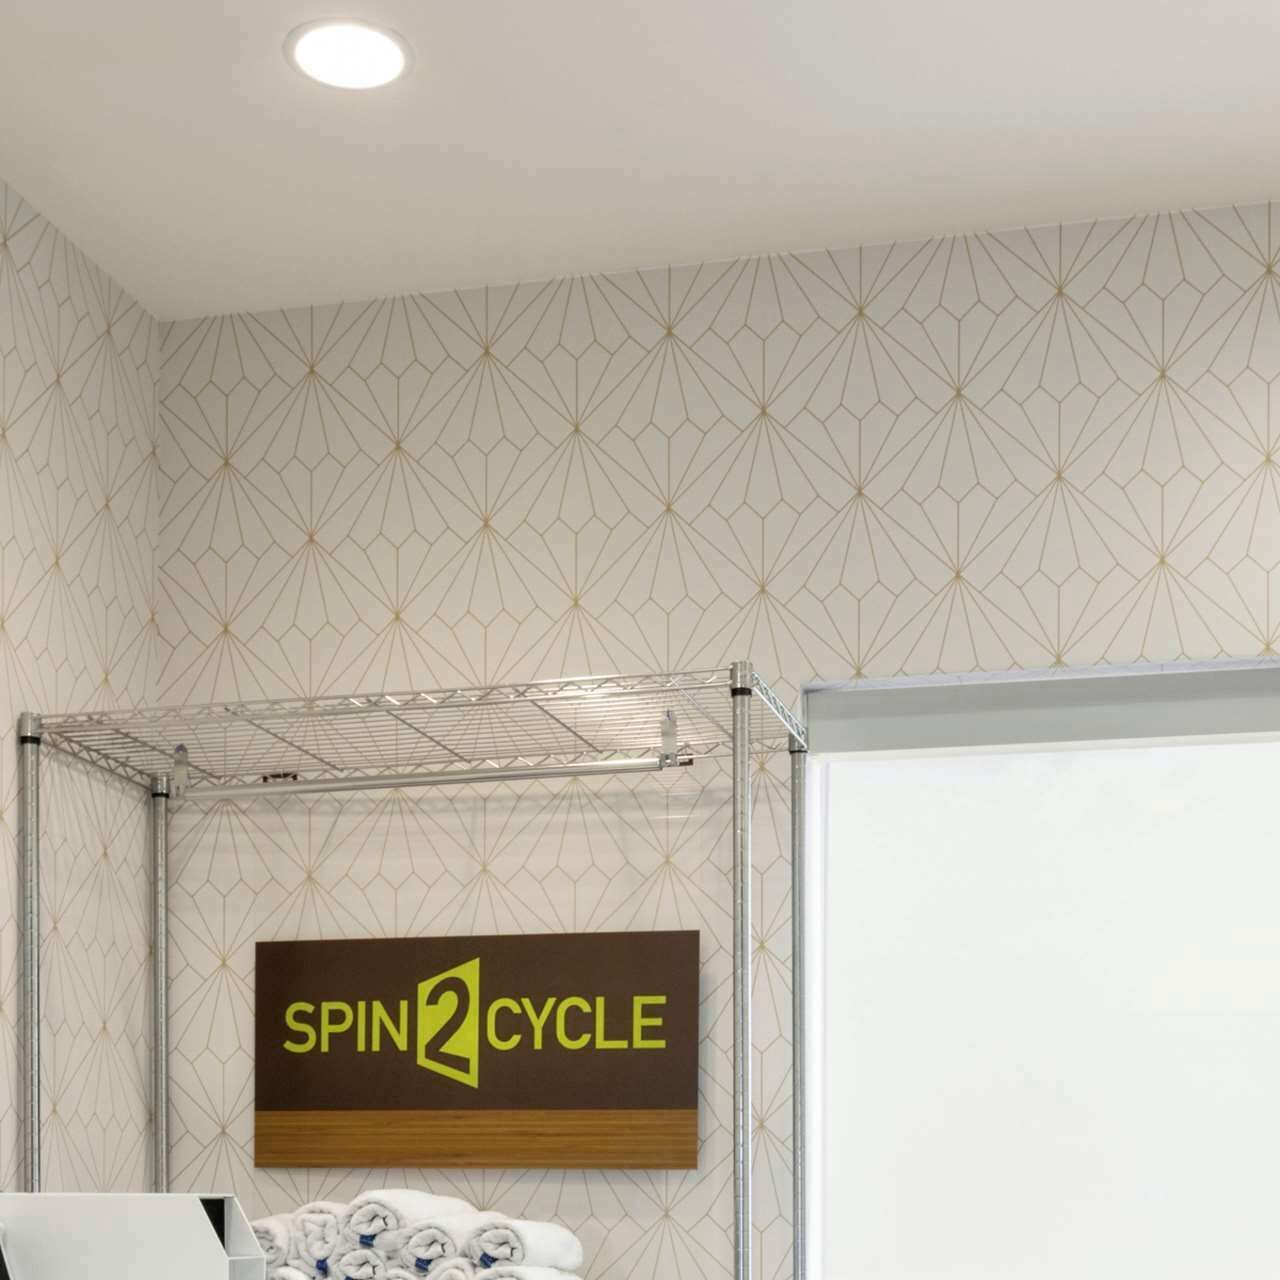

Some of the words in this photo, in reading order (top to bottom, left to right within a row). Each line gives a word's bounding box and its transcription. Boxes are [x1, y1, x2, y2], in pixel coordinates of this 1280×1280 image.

[282, 999, 409, 1053] SPIN
[424, 976, 471, 1075] 2
[486, 995, 667, 1051] CYCLE
